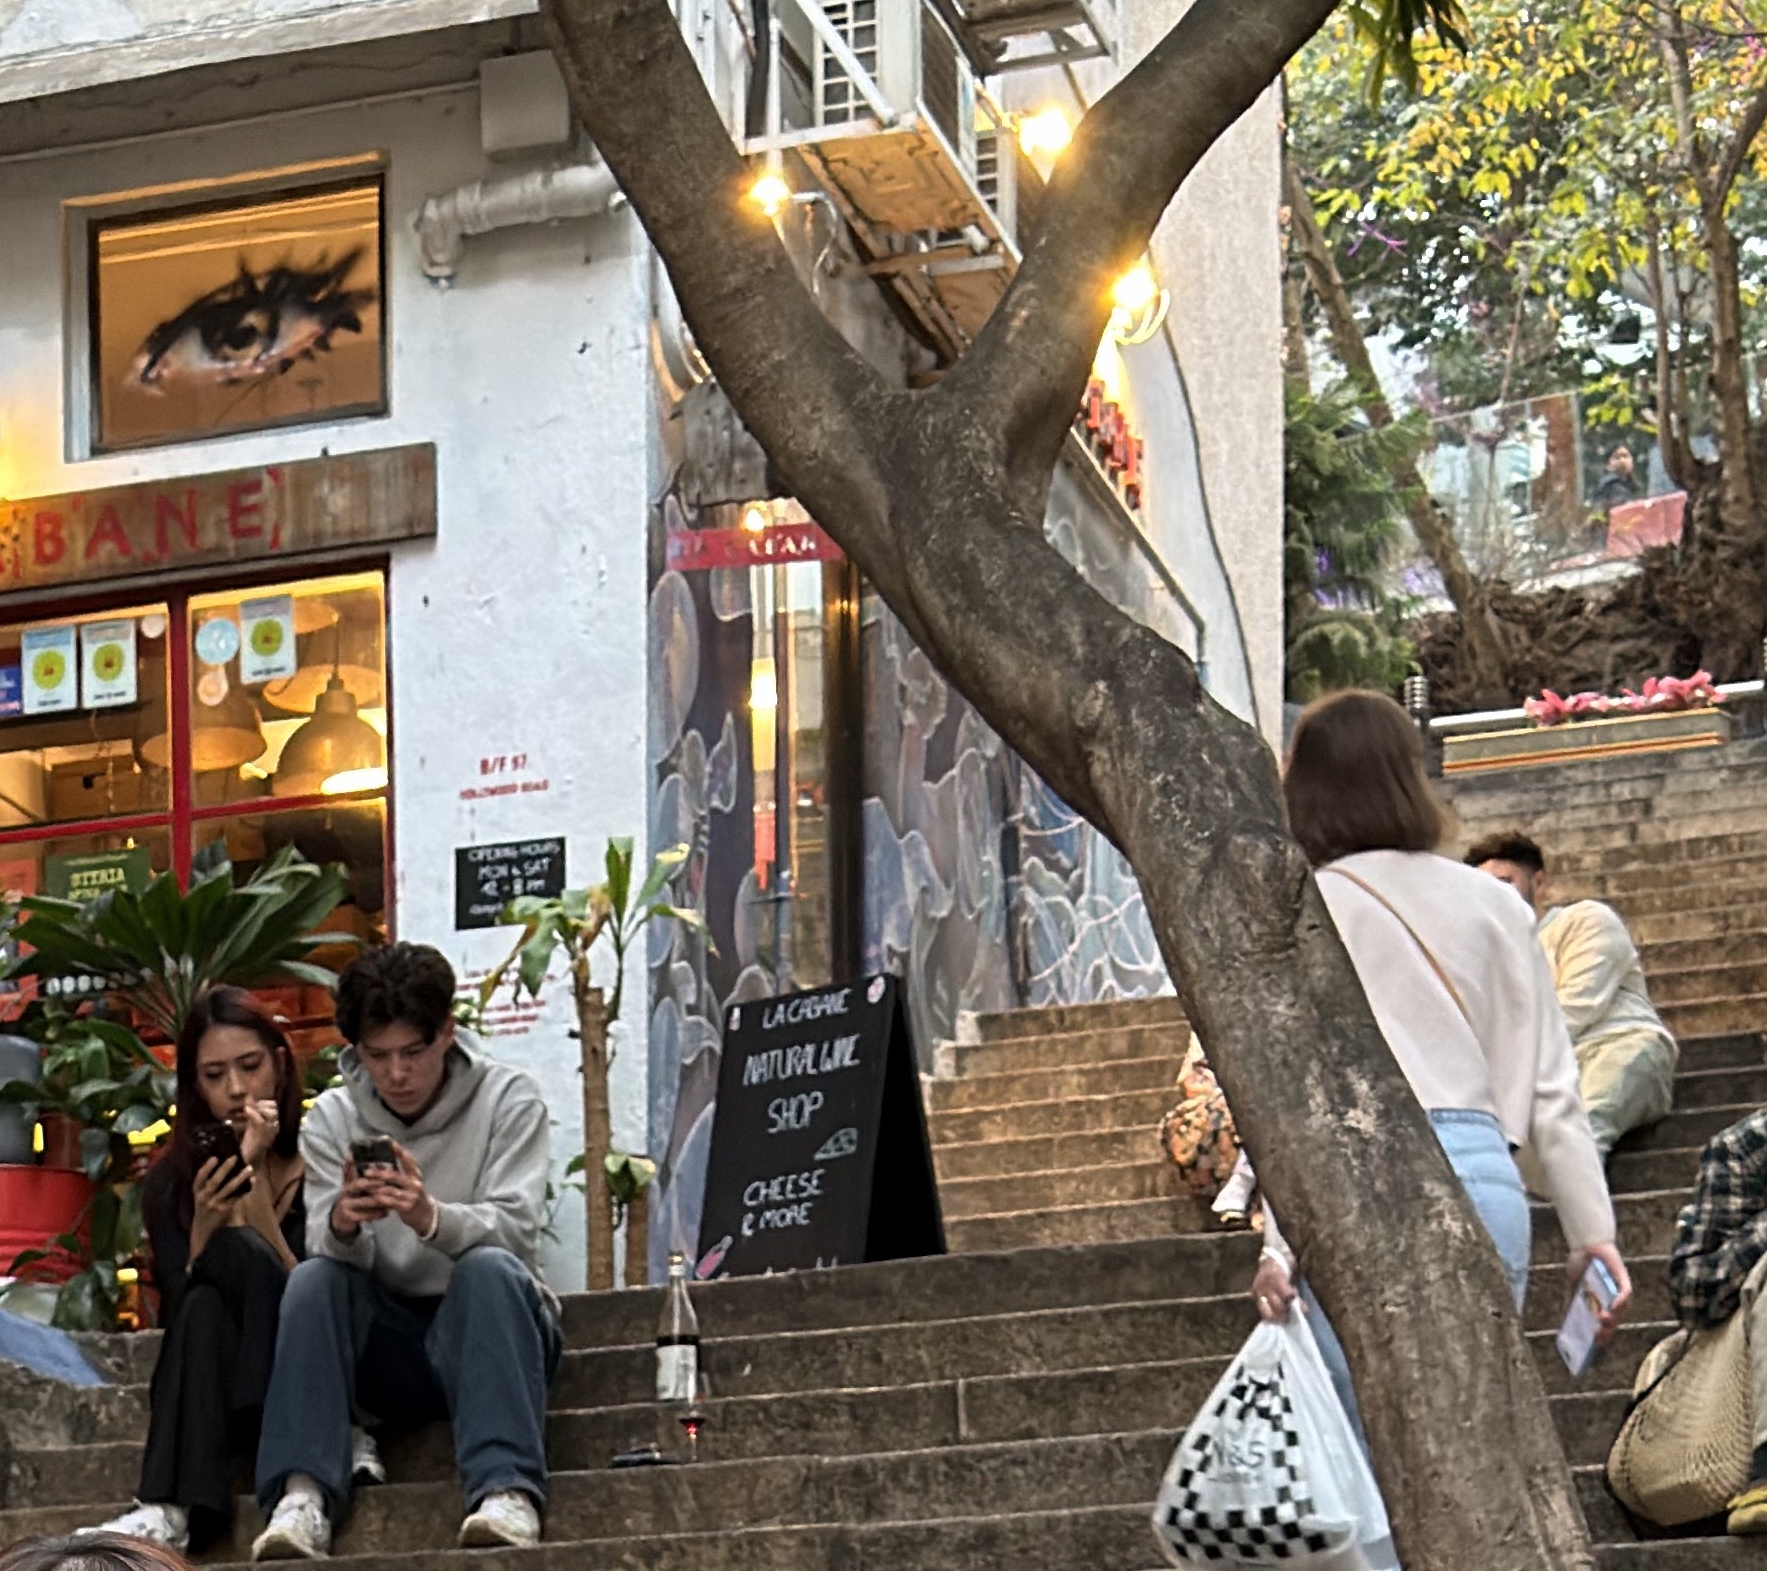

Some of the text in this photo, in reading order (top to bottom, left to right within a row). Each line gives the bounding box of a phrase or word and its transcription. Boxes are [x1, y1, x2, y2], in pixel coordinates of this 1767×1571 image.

[742, 1043, 818, 1086] NATURAL
[767, 1091, 824, 1134] SHOP
[743, 1168, 827, 1207] CHEESE
[759, 1201, 814, 1230] MORE
